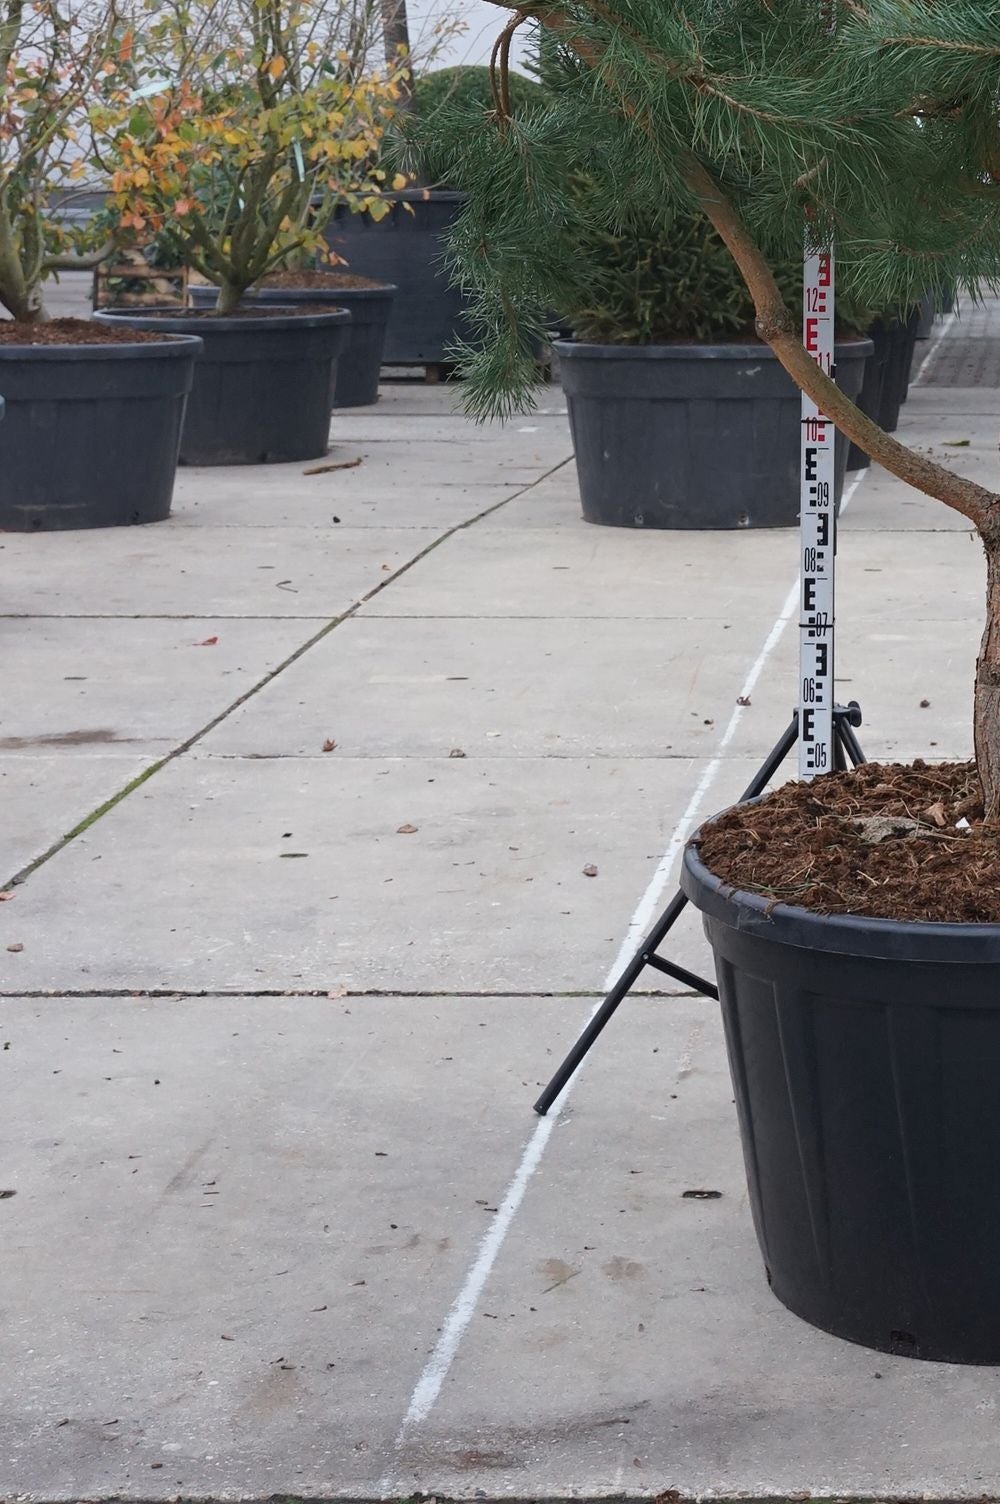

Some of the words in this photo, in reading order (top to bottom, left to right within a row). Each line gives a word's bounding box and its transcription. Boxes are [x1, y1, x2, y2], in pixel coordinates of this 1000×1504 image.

[806, 287, 818, 313] 12
[818, 352, 830, 377] 11
[806, 416, 817, 442] 10
[817, 482, 829, 507] 09
[804, 547, 816, 573] 08
[816, 612, 828, 637] 07
[803, 677, 815, 703] 06
[814, 742, 827, 768] 05
